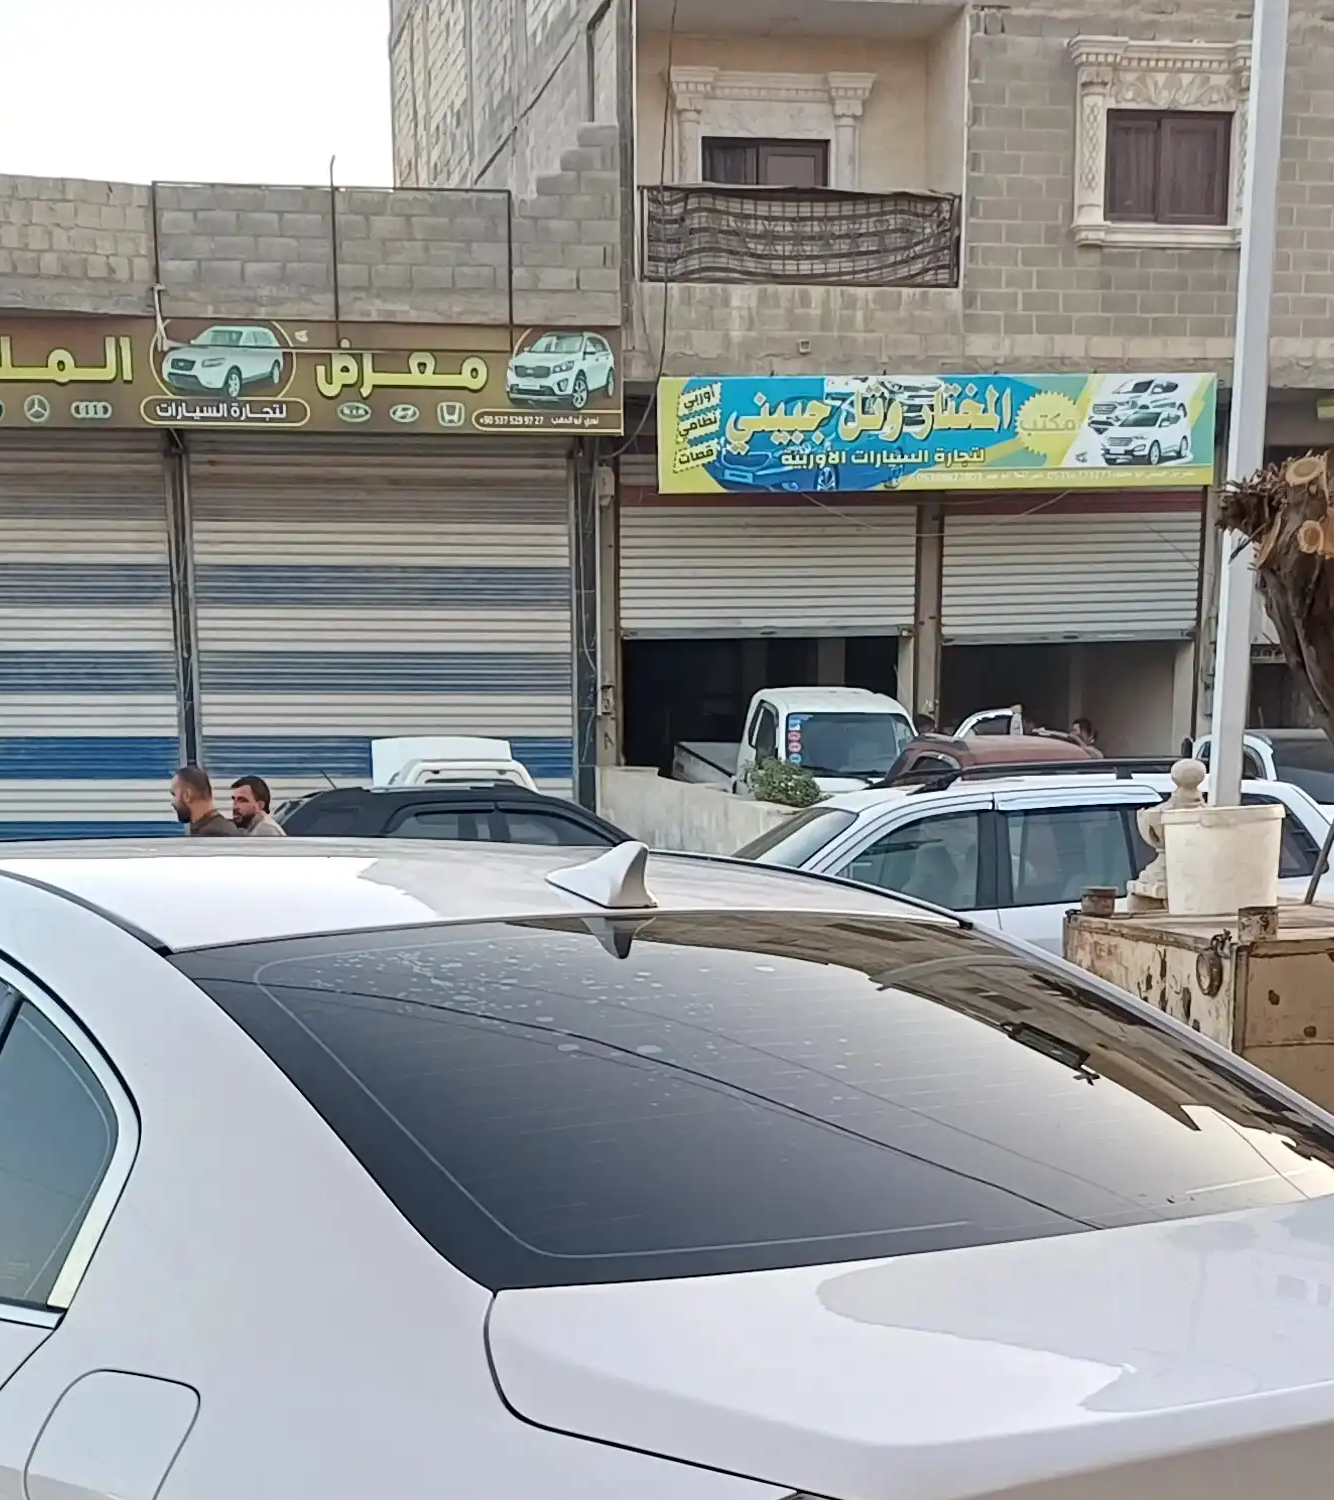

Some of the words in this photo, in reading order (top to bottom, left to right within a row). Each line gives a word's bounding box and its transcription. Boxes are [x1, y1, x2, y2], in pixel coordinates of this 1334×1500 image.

[315, 338, 488, 398] معرض
[155, 402, 228, 420] السيارات
[231, 403, 287, 421] لتجارة
[908, 382, 1012, 441] المختار
[678, 411, 717, 439] نظامي
[1019, 413, 1076, 437] مكتب
[678, 445, 714, 465] قصات
[851, 449, 929, 468] السيارات
[934, 448, 986, 467] لتجارة
